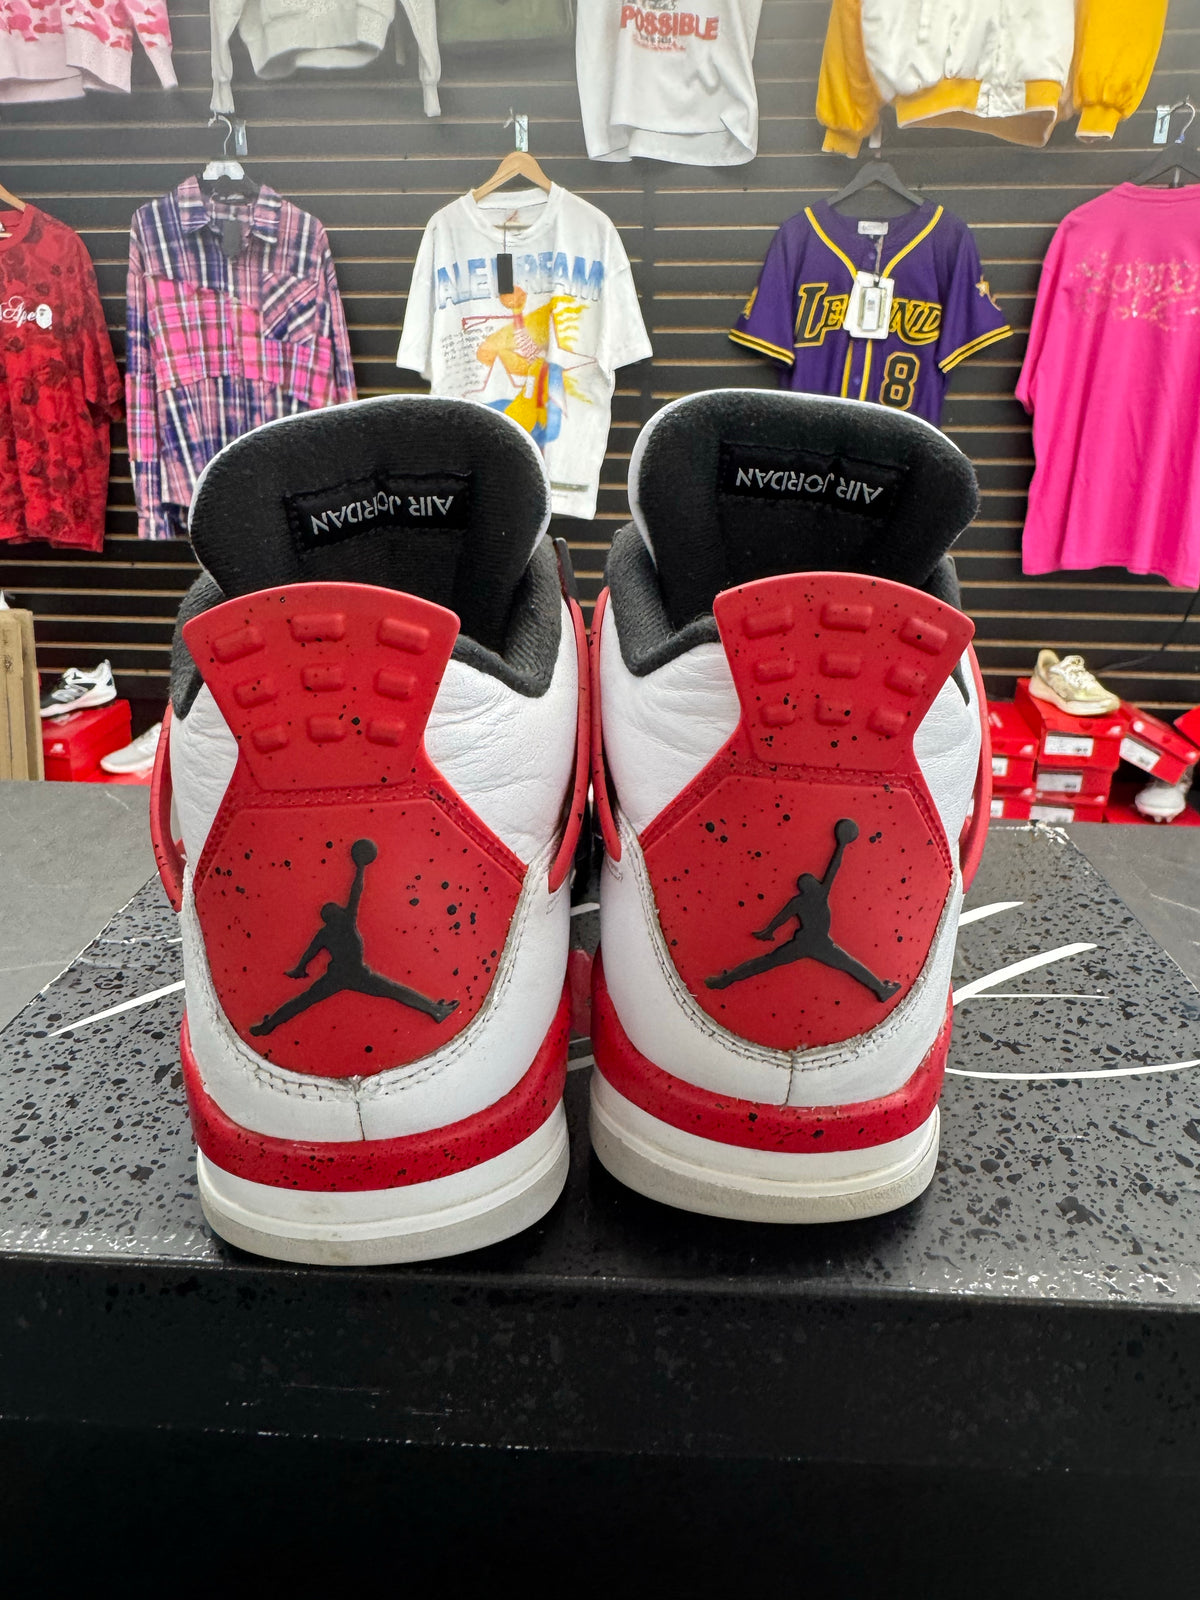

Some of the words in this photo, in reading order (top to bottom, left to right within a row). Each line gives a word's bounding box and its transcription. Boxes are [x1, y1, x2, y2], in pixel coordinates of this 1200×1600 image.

[620, 5, 719, 40] POSSIBLE
[794, 282, 942, 346] LEND
[879, 351, 920, 411] 8
[735, 467, 835, 493] JORDAN
[834, 477, 884, 504] AIR
[310, 490, 402, 535] JORDAN
[408, 495, 454, 516] AIR
